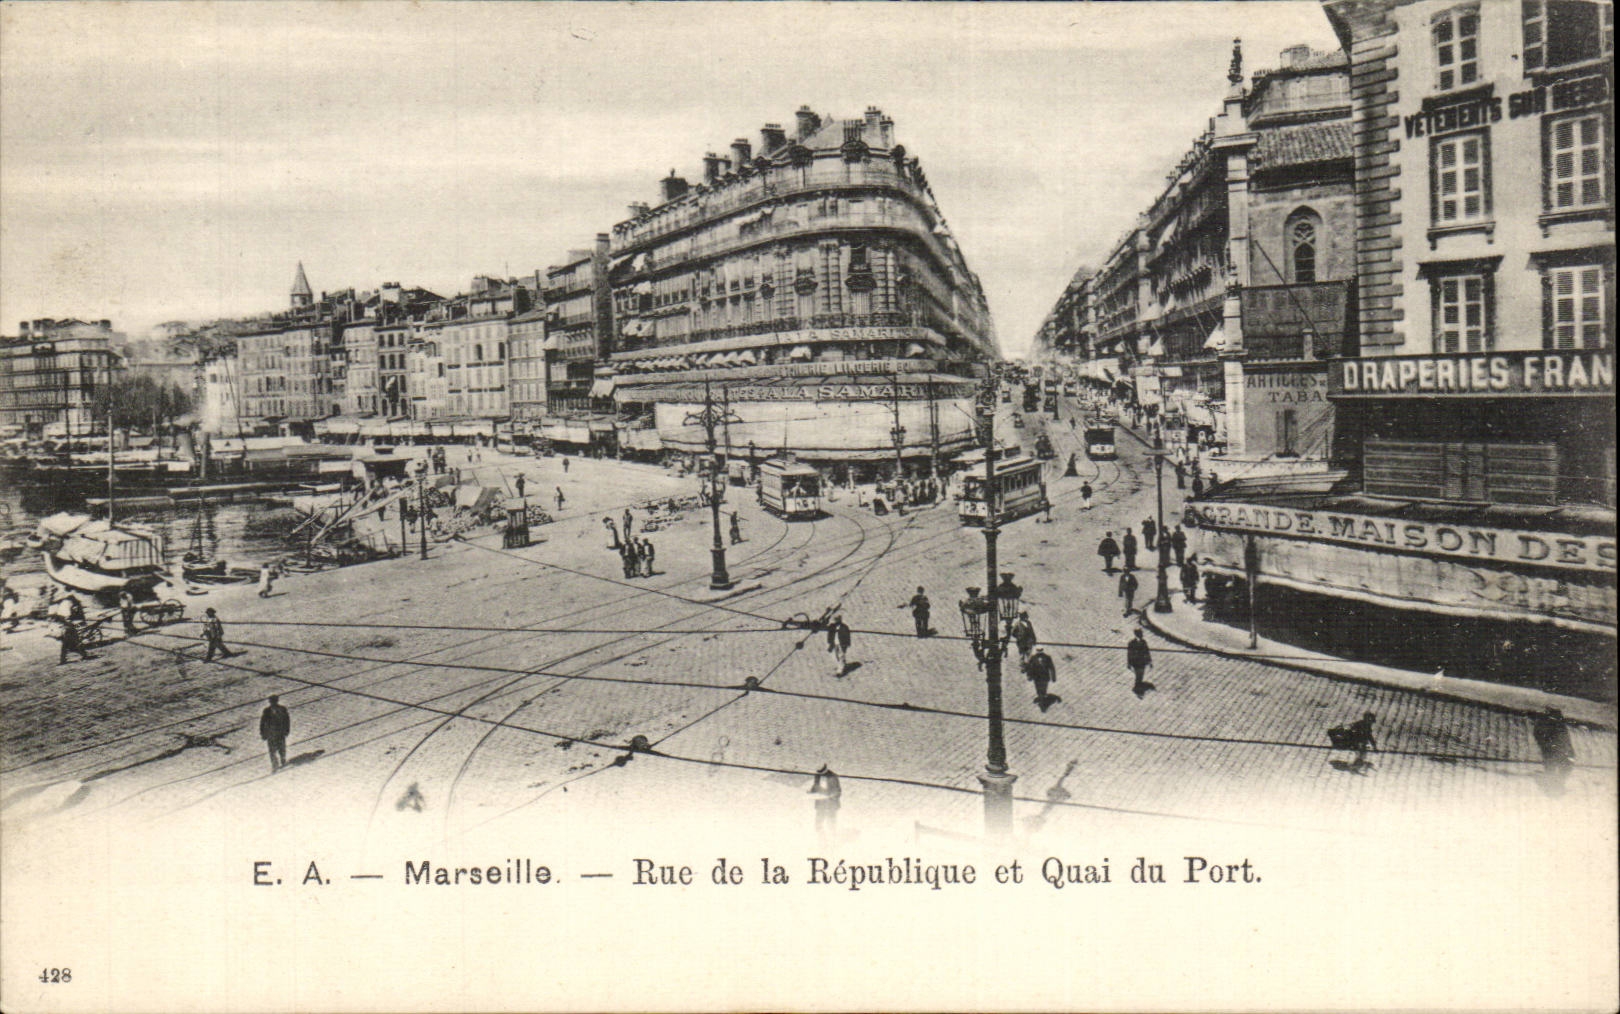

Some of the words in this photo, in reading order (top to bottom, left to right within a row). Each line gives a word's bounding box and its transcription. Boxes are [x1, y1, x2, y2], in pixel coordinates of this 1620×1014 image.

[1342, 357, 1509, 390] DRAPERIES
[1523, 353, 1613, 388] FRAN
[1328, 515, 1497, 556] MAISON
[1517, 534, 1615, 568] DES
